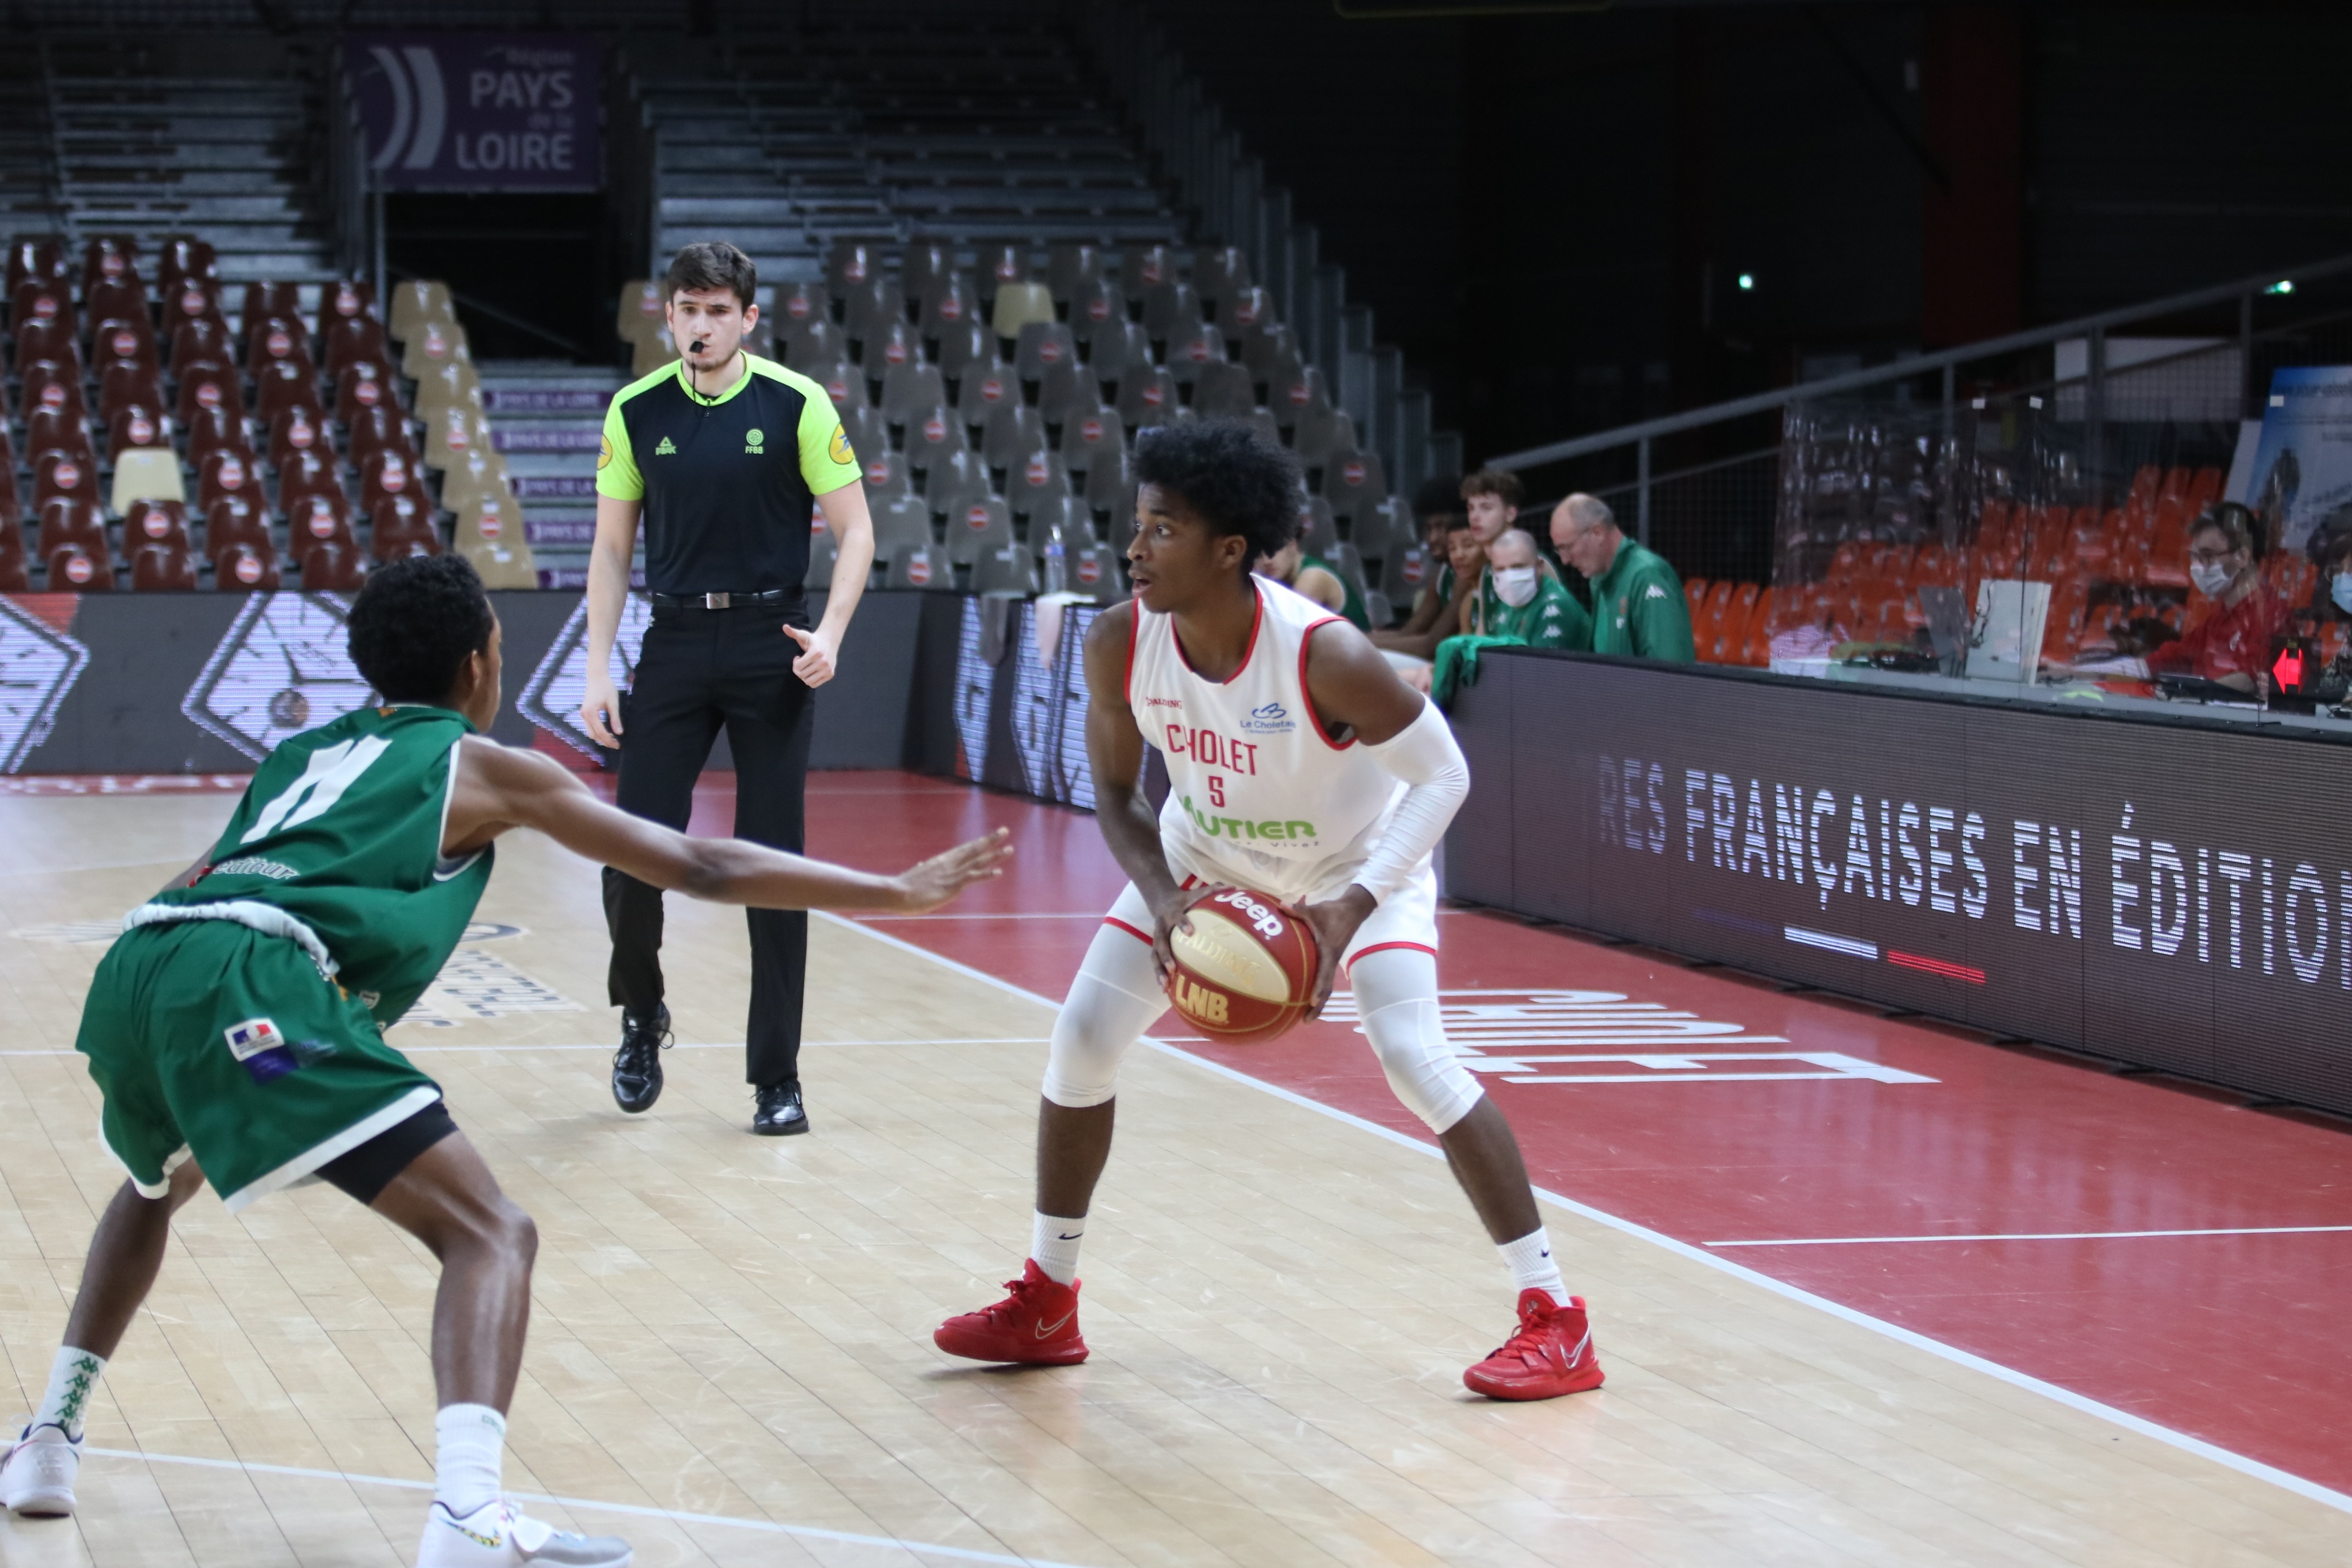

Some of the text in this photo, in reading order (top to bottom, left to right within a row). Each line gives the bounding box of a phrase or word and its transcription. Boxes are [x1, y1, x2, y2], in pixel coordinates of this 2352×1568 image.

[471, 70, 575, 109] PAYS
[456, 132, 574, 171] LOIRE
[745, 446, 764, 454] FFBB
[1240, 720, 1252, 729] Le
[1166, 724, 1257, 776] CHOLET
[239, 734, 393, 845] 11
[1208, 775, 1226, 808] 5
[1685, 767, 1988, 919] FRANÇAISES
[2013, 820, 2082, 940] EN
[1213, 891, 1283, 937] Jeep
[1175, 974, 1229, 1022] LNB
